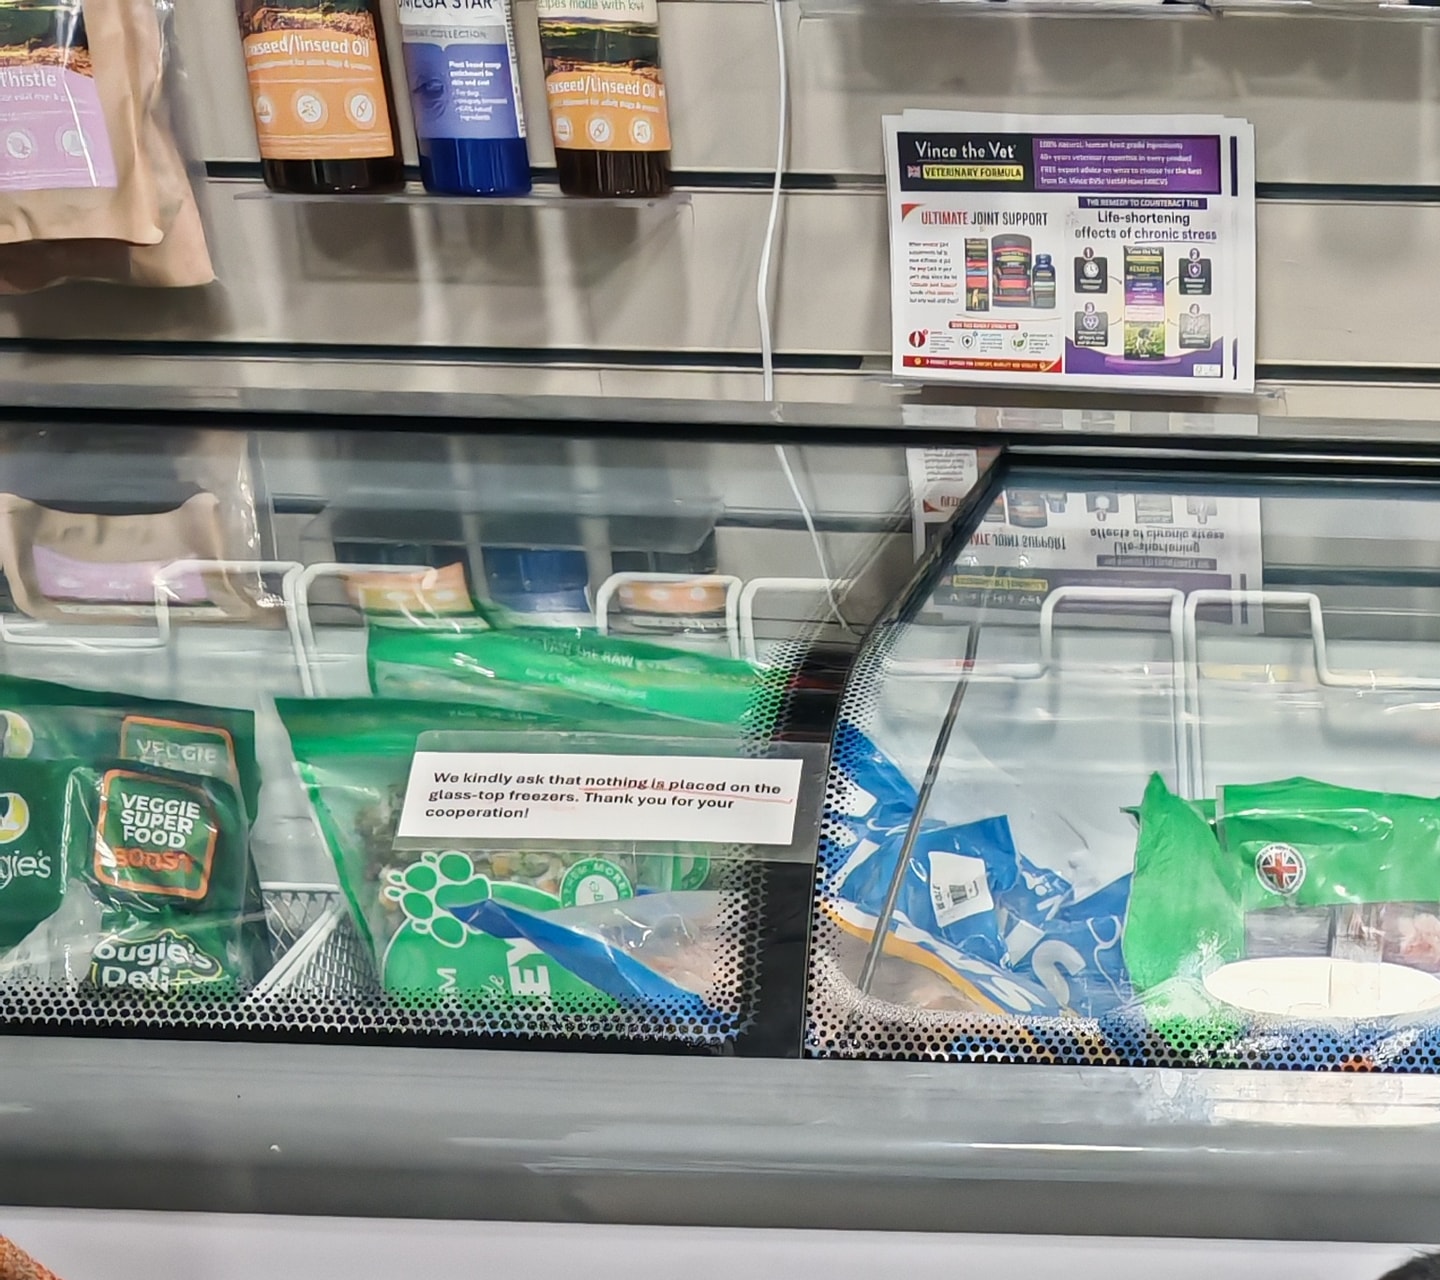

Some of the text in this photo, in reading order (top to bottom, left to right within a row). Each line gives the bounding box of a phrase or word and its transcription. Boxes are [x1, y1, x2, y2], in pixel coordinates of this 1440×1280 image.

[352, 38, 369, 57] Oil
[0, 70, 57, 87] Thistle
[642, 83, 656, 98] Oil
[915, 141, 1014, 158] Vince the Vet
[925, 166, 1022, 178] VETERINARY FORMULA
[921, 211, 1048, 226] ULTIMATE JOINT SUPPORT
[1098, 211, 1190, 226] Life-shortening
[1075, 226, 1217, 240] effects of chronic stress
[433, 772, 781, 795] We kindly ask that nothing is placed on the
[120, 792, 201, 820] VEGGIE
[428, 789, 735, 810] glass-top freezers. Thank you for your
[120, 809, 194, 835] SUPER
[425, 807, 529, 820] cooperation!
[123, 826, 186, 848] FOOD
[0, 850, 52, 891] gie's
[93, 936, 213, 970] ougie's
